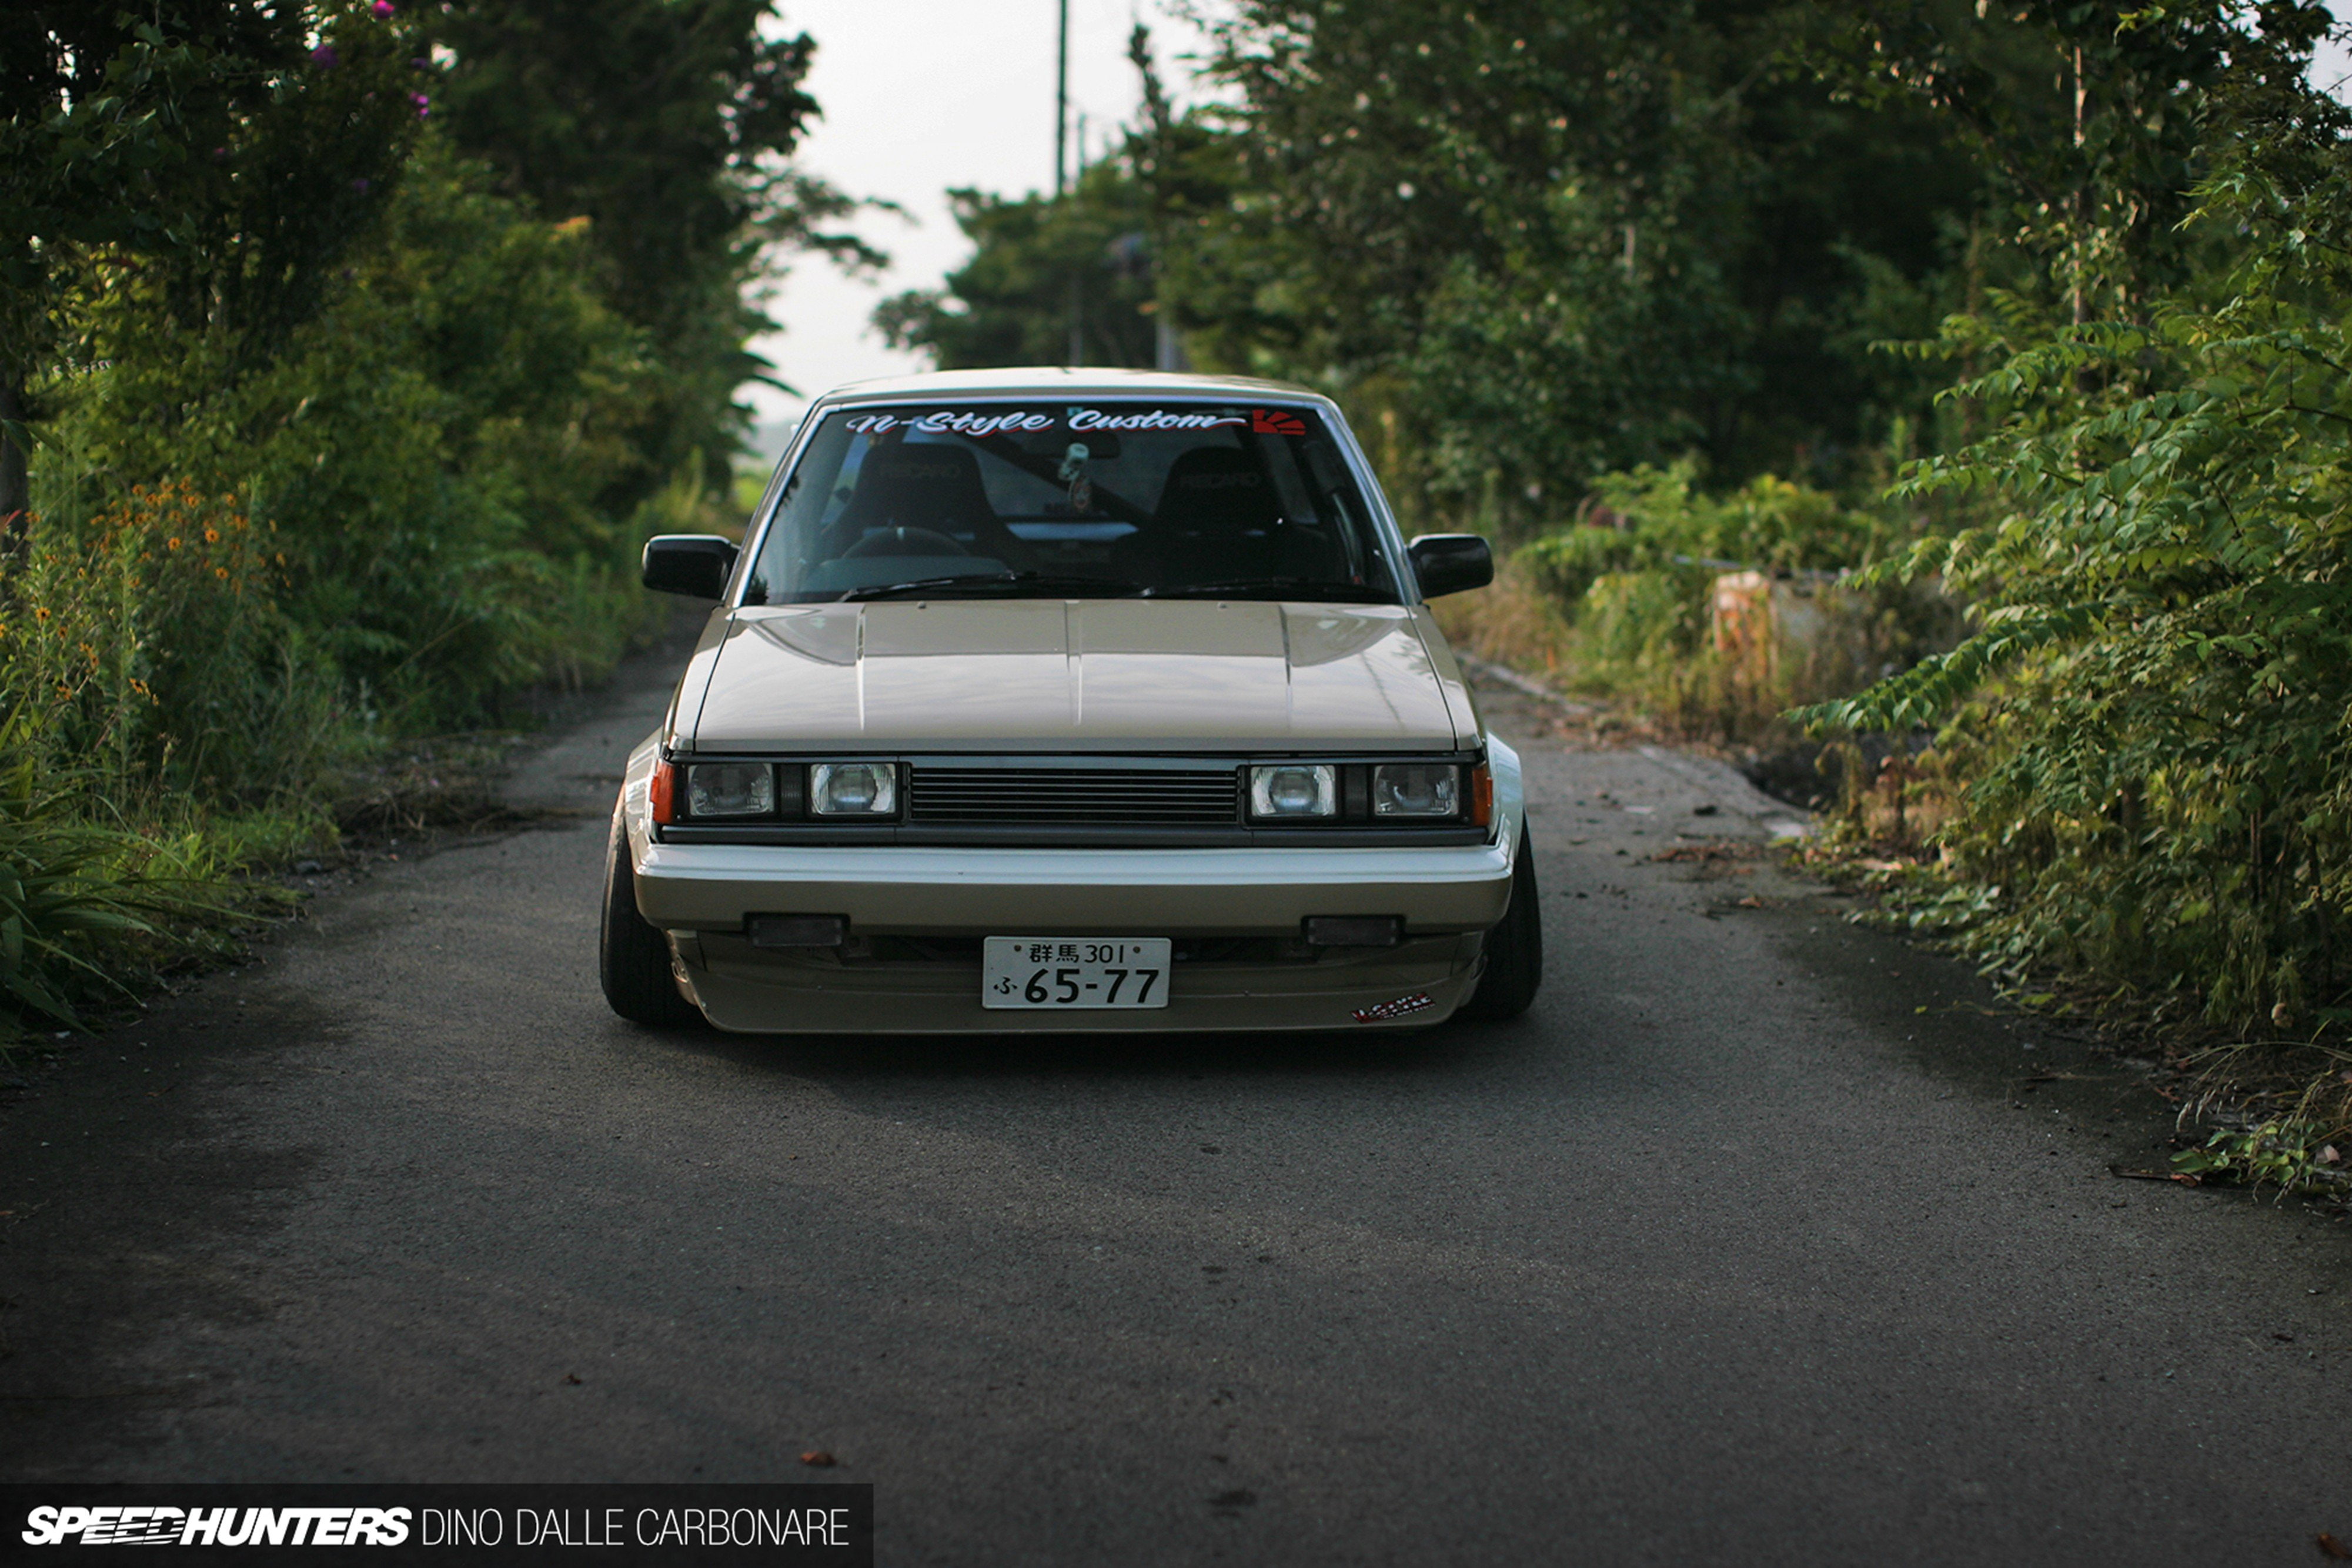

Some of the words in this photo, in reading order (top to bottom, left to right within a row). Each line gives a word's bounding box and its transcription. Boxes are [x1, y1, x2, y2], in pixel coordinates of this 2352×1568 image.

[1068, 410, 1248, 433] Custom
[1029, 944, 1080, 964] 群馬
[1084, 944, 1124, 964] 301
[993, 977, 1018, 995] ふ
[1024, 968, 1160, 1004] 65-77
